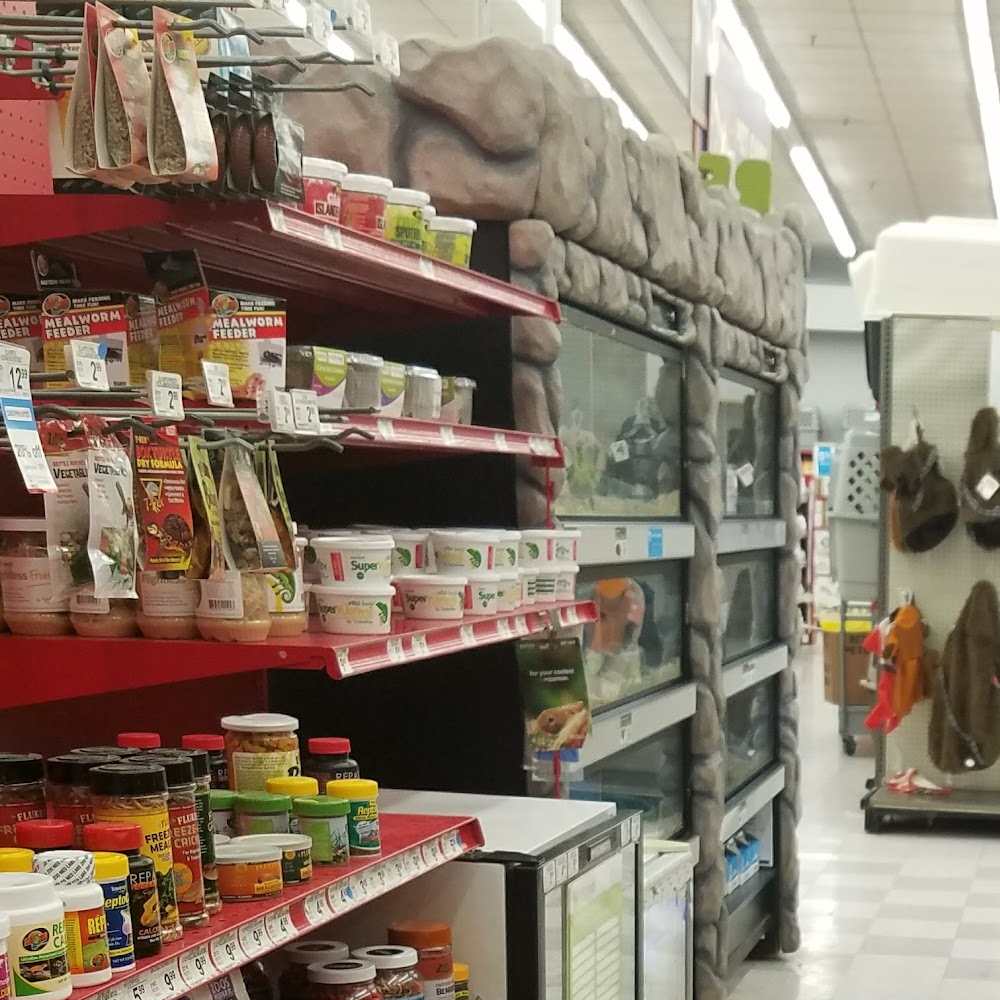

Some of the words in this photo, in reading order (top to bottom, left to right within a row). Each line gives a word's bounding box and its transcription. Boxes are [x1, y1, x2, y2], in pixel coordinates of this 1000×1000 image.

[44, 311, 121, 329] MEALWORM
[212, 316, 283, 328] MEALWORM
[46, 325, 91, 339] FEEDER
[213, 328, 256, 339] FEEDER
